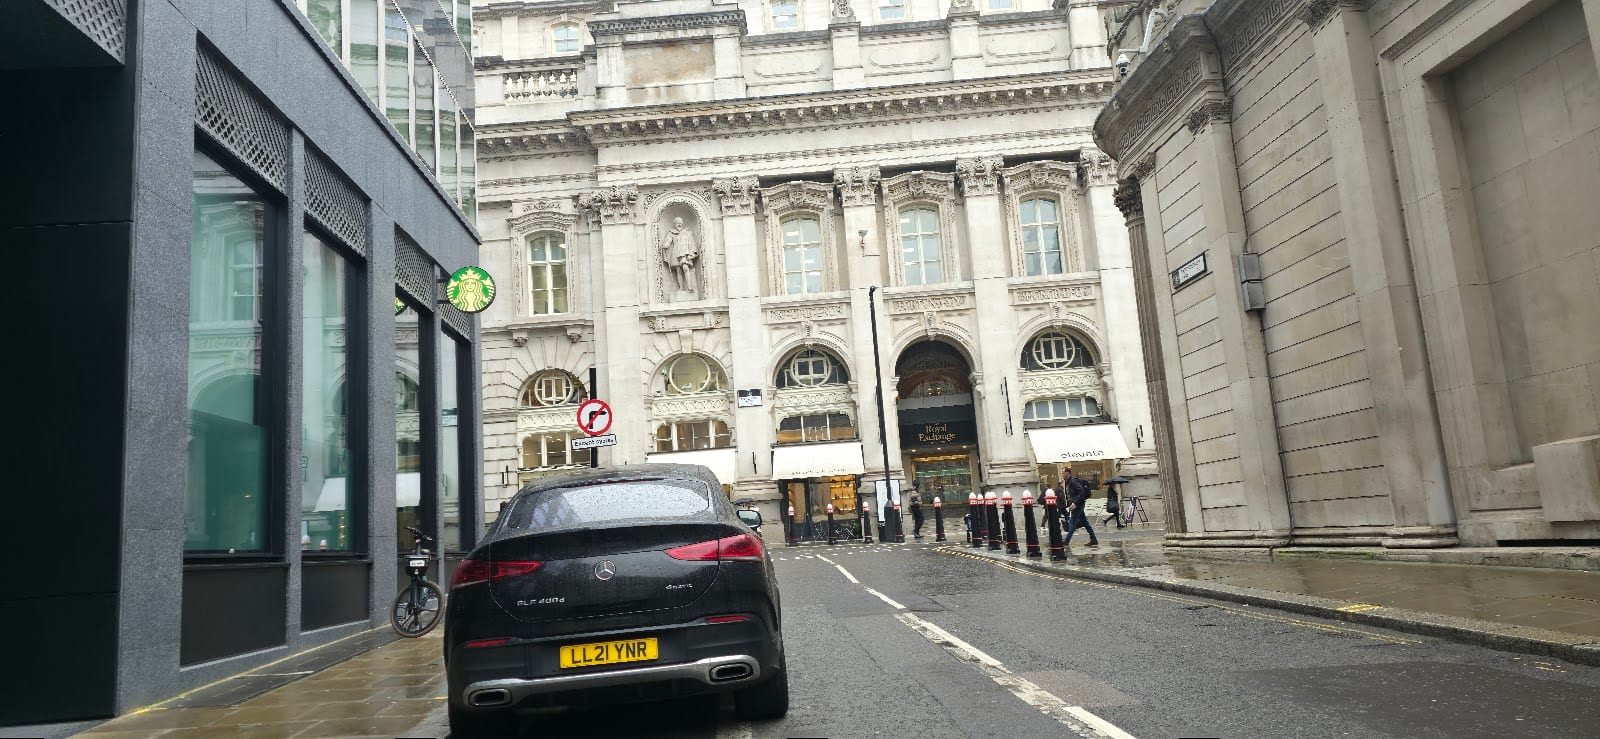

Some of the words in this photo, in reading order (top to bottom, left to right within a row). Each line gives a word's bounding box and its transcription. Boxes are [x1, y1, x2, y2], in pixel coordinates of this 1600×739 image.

[925, 424, 947, 434] Royal
[918, 433, 956, 441] Exchange
[571, 645, 609, 664] LL21
[614, 641, 647, 660] YNR
